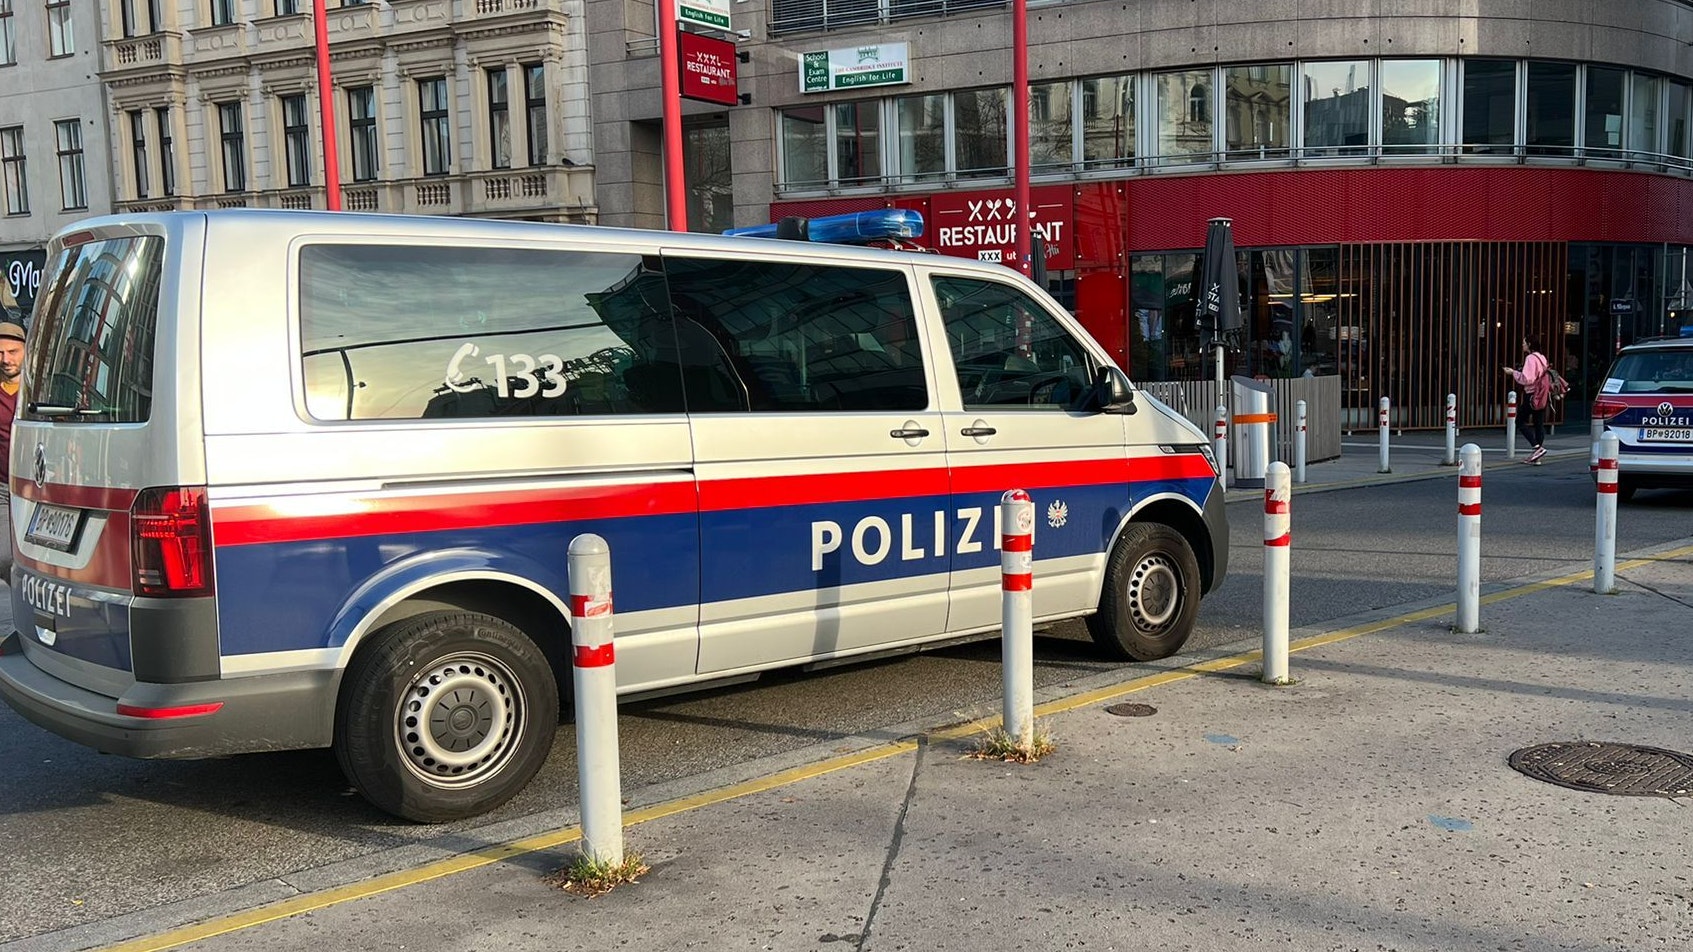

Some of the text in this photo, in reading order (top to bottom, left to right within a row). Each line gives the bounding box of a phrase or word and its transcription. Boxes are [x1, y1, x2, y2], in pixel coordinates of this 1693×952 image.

[696, 51, 721, 66] XXXL
[806, 52, 827, 61] School
[686, 61, 731, 78] RESTAURANT
[806, 75, 828, 84] Centre
[842, 71, 896, 84] English for Life
[980, 251, 1000, 261] XXX
[485, 353, 567, 398] 133
[1642, 417, 1689, 425] POLIZEI
[22, 573, 72, 617] POLIZEI
